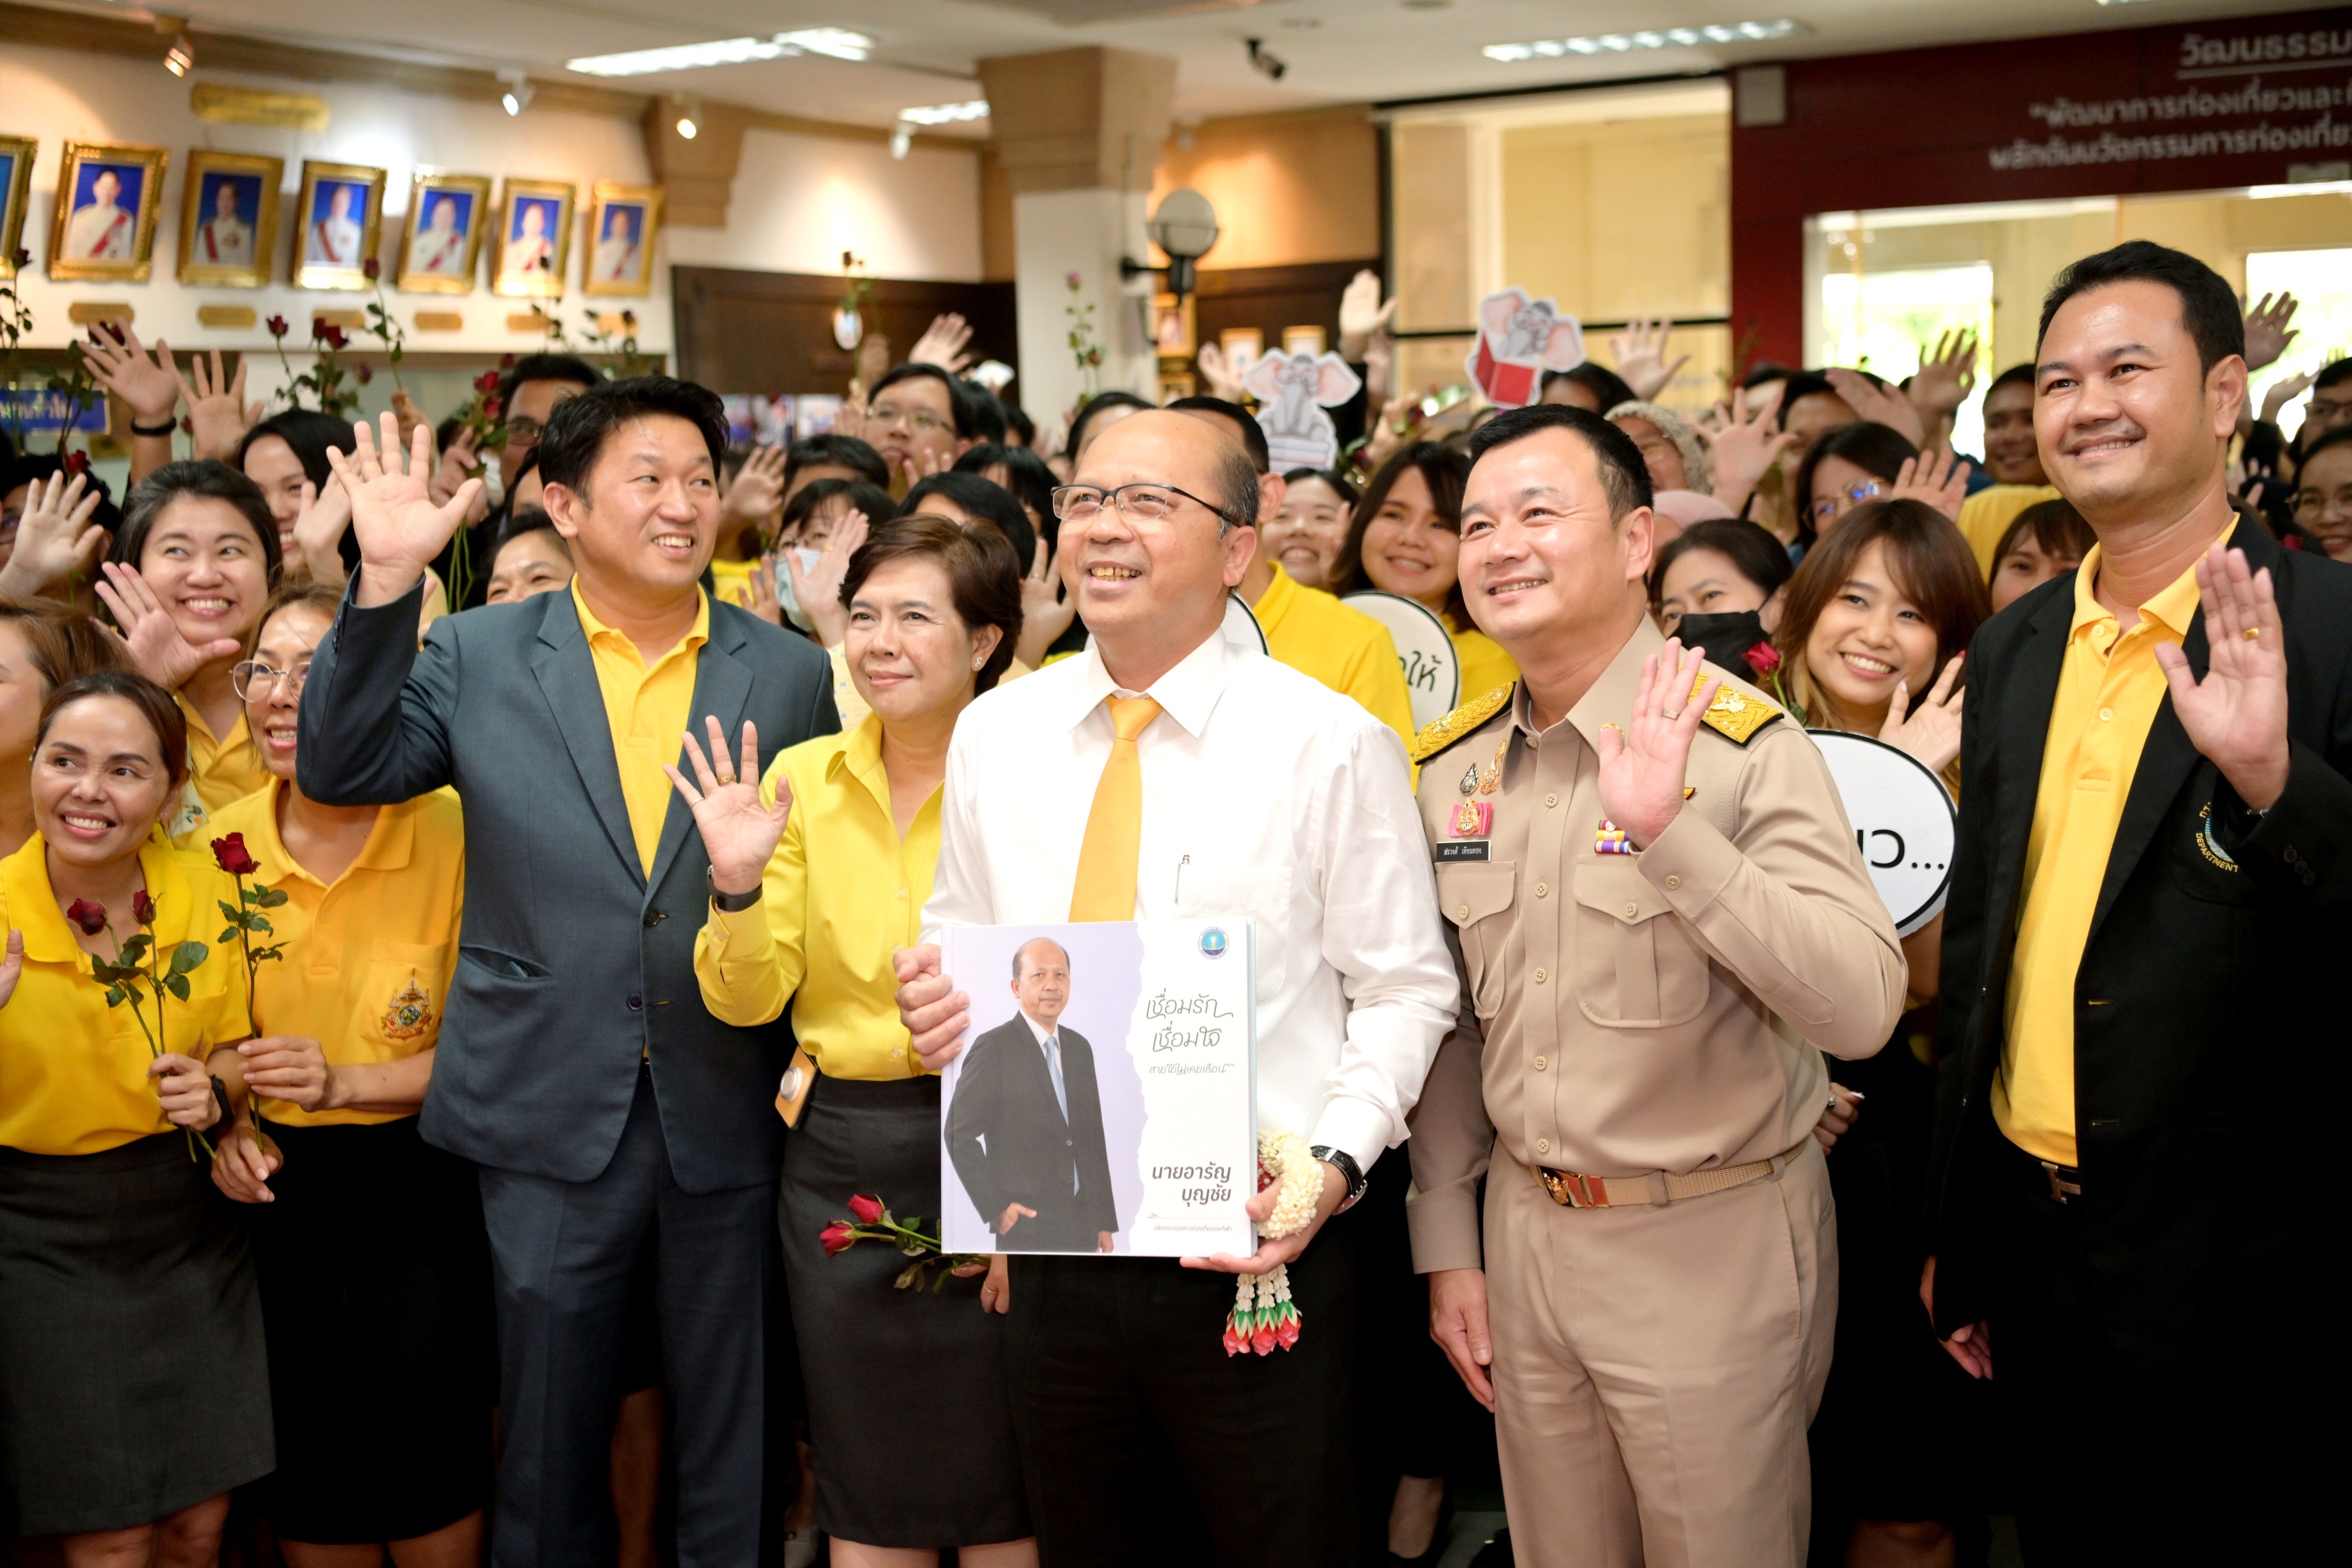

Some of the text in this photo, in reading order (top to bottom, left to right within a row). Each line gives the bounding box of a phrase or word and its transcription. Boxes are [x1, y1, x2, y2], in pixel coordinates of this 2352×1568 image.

[2200, 802, 2211, 818] กร
[1444, 846, 1481, 856] สรวงศ์ เทียนทอง
[2195, 832, 2239, 872] DEPARTMENT
[1146, 987, 1234, 1019] เชื่อมรัก
[1153, 1020, 1222, 1052] เชื่อมใจ
[1152, 1161, 1231, 1183] นายอารัญ
[1182, 1183, 1231, 1207] บุญชัย
